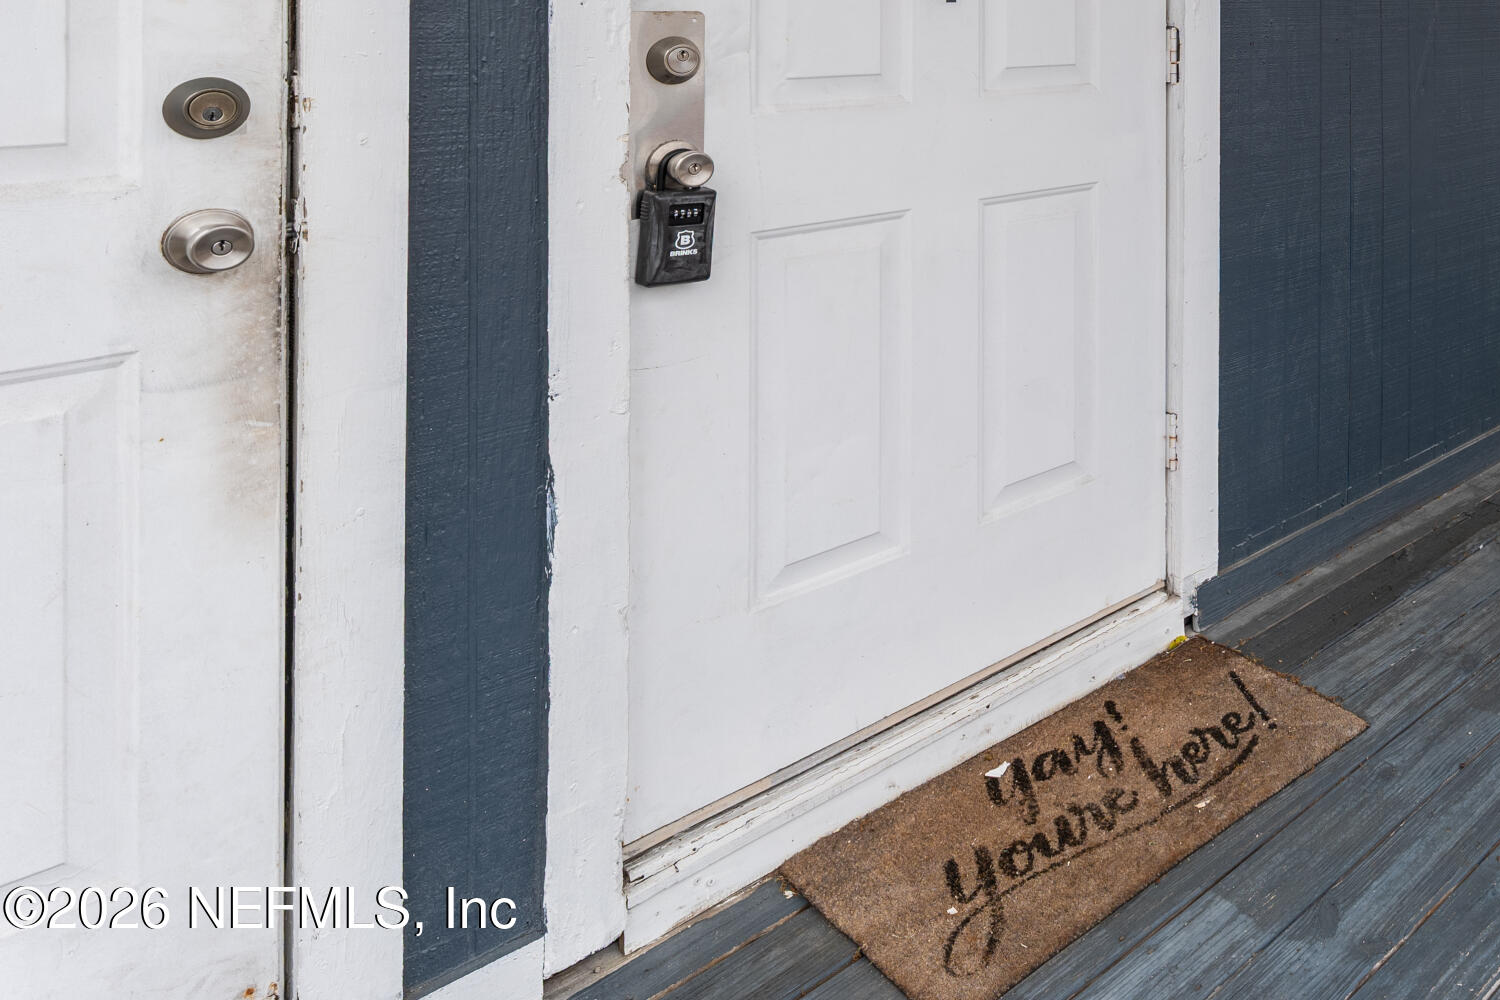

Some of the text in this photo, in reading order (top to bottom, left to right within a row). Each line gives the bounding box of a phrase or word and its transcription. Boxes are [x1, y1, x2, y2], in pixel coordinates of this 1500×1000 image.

[670, 248, 698, 257] BRINKS
[985, 700, 1128, 825] yay!
[1131, 670, 1277, 797] here!
